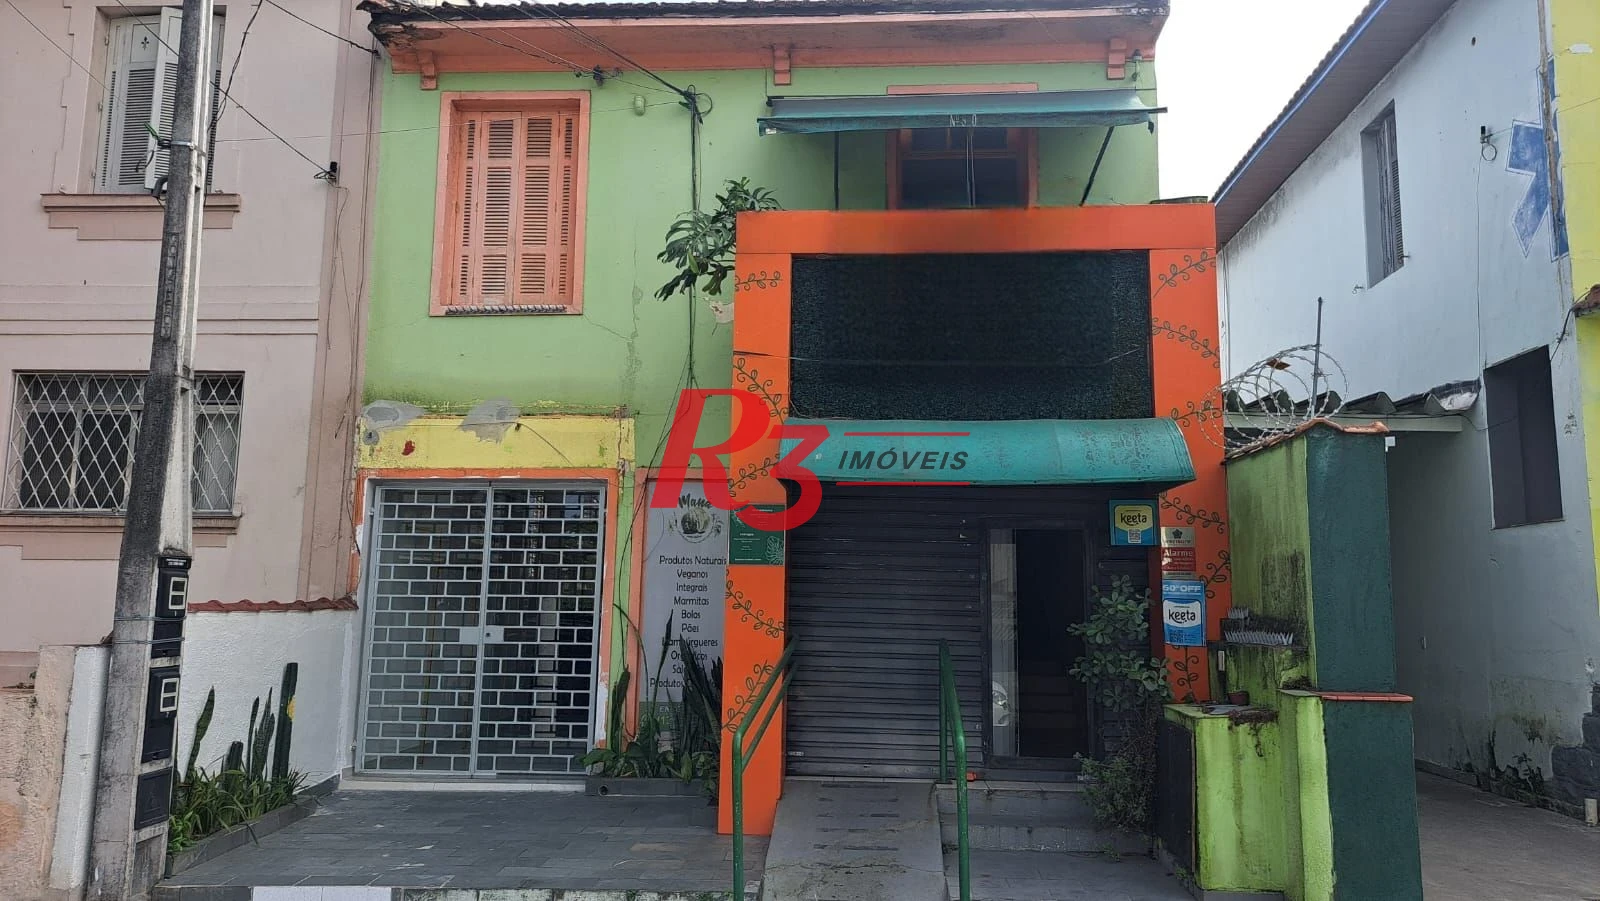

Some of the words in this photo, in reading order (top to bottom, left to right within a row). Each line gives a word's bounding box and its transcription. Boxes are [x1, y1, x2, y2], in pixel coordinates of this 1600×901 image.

[1121, 513, 1147, 525] keeta
[1164, 549, 1194, 557] Alarme
[659, 555, 693, 565] Produtos
[694, 555, 727, 565] Naturais
[677, 569, 708, 579] Veganos
[676, 582, 708, 593] Integrais
[1180, 585, 1201, 593] OFF
[673, 596, 709, 605] Marmitas
[681, 609, 701, 618] Bolos
[1168, 608, 1196, 623] keeta
